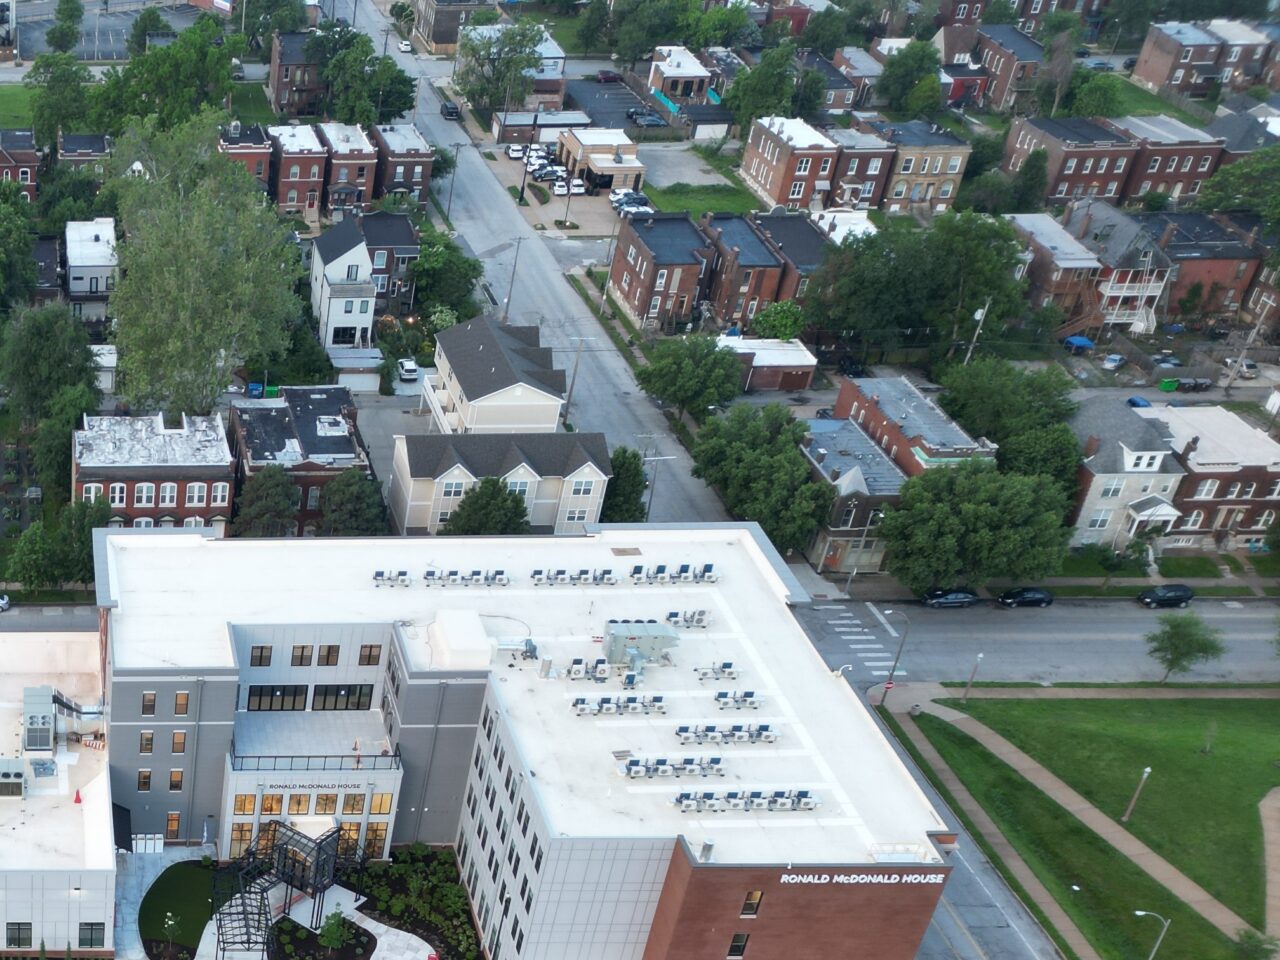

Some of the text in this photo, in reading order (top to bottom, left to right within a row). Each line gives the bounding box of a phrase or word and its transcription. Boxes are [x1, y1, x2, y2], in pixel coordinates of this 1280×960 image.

[780, 874, 945, 884] RONALD McDONALD HOUSE
